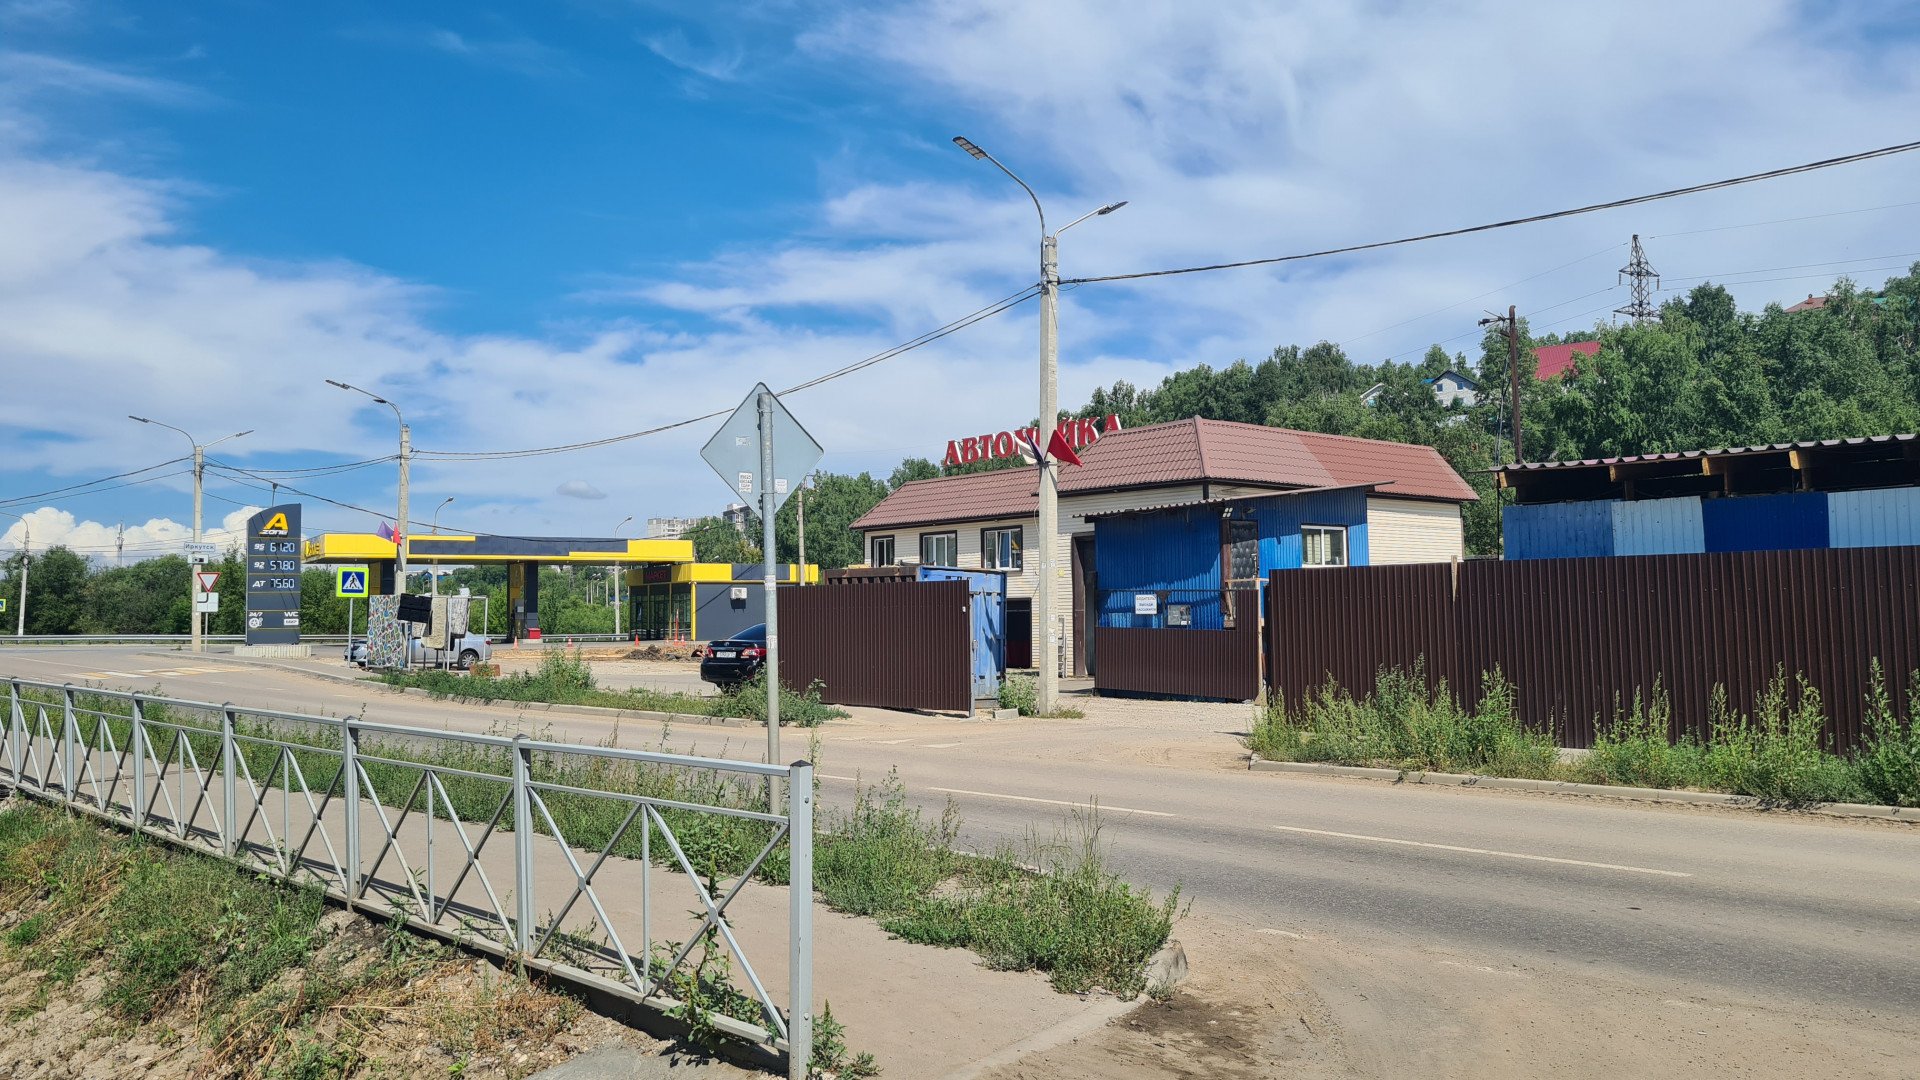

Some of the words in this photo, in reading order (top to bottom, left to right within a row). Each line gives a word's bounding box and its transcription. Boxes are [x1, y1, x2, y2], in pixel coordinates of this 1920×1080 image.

[944, 413, 1122, 466] АВТОМЙКА
[254, 543, 265, 551] 95
[254, 562, 265, 570] 92
